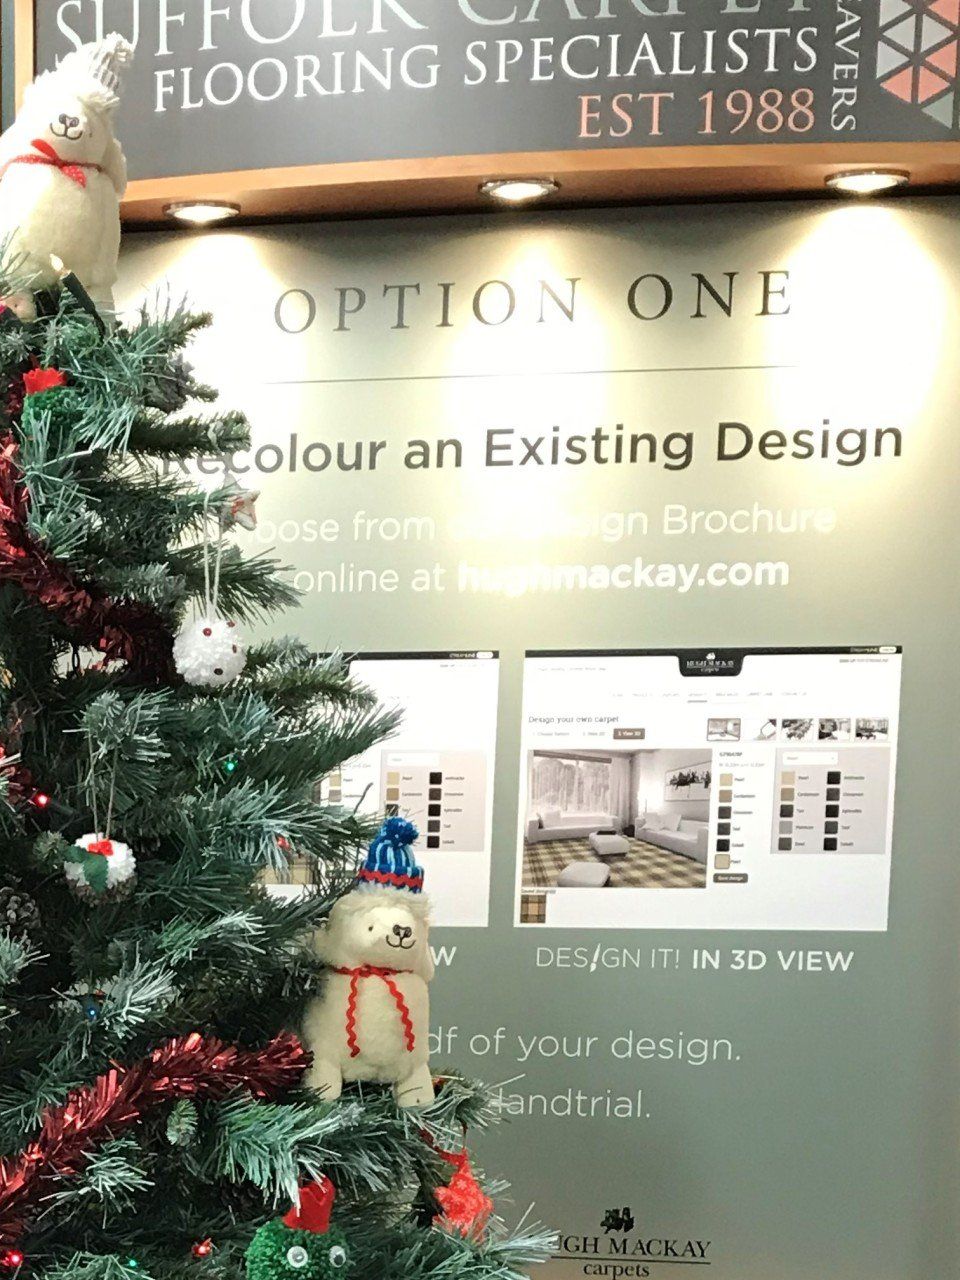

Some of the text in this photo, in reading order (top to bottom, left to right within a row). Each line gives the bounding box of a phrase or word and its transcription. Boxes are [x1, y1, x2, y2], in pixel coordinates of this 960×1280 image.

[154, 27, 818, 112] FLOORING SPECIALISTS
[578, 88, 815, 138] EST 1988
[273, 270, 791, 334] OPTION ONE
[404, 438, 462, 469] an
[485, 423, 694, 471] Existing
[717, 419, 902, 466] Design
[352, 510, 436, 541] from
[663, 502, 837, 536] Brochure
[293, 562, 399, 593] online
[411, 563, 446, 592] at
[651, 948, 679, 969] IT!
[692, 949, 720, 970] IN
[730, 949, 767, 971] 3D
[777, 949, 854, 972] VIEW
[469, 1027, 506, 1055] of
[517, 1034, 599, 1062] your
[611, 1030, 741, 1065] design.
[609, 1236, 712, 1259] MACKAY
[583, 1261, 650, 1280] carpets
